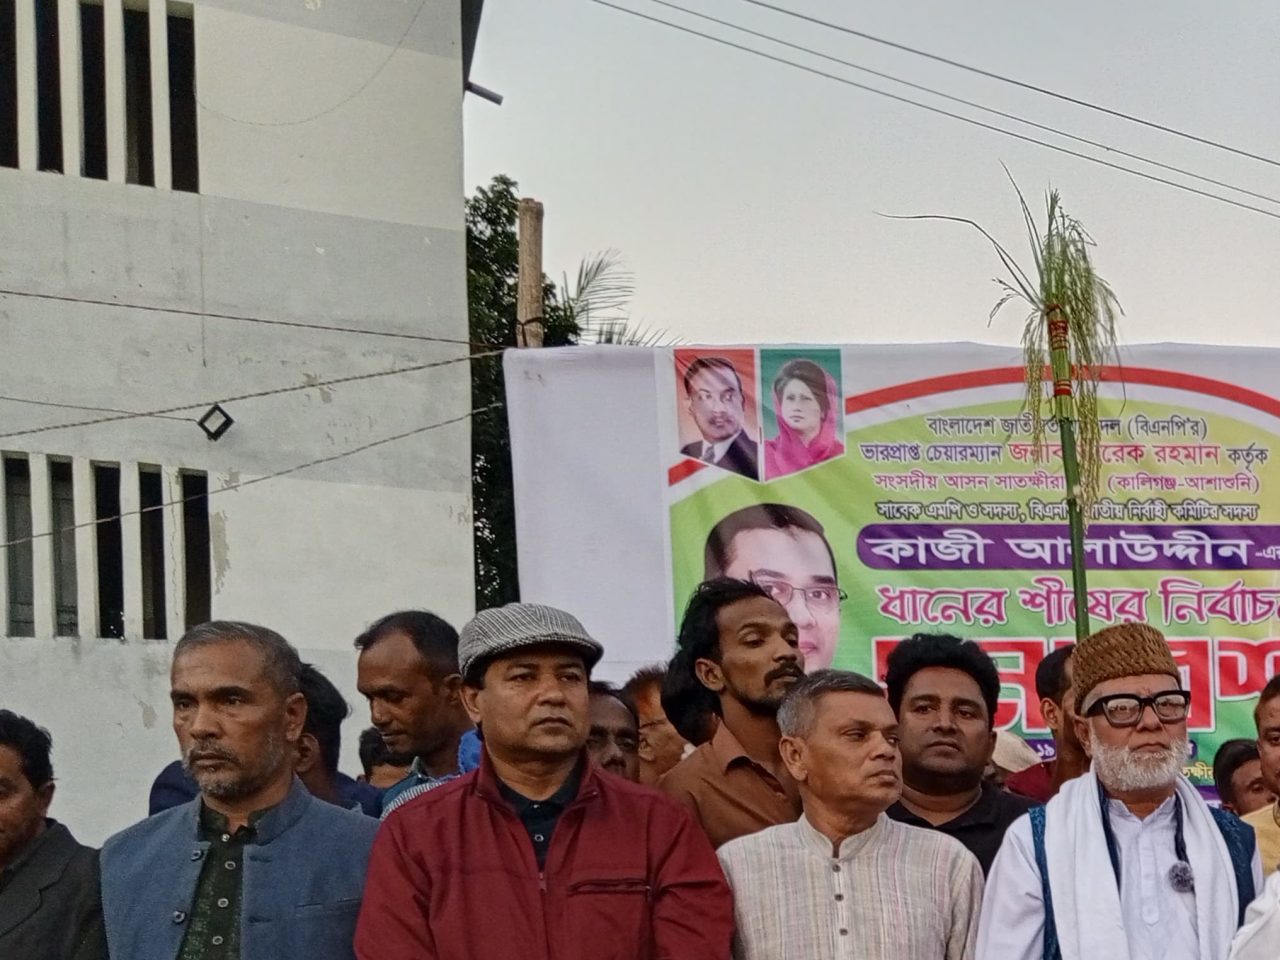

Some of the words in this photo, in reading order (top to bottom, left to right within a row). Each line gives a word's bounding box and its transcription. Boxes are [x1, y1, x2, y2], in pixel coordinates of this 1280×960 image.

[927, 417, 995, 435] বাংলাদেশ
[861, 443, 921, 462] ভারপ্রাপ্ত
[927, 444, 1001, 463] চেয়ারম্যান
[1154, 444, 1220, 464] রহমান
[1226, 442, 1268, 472] কর্তৃক
[874, 470, 938, 489] সংসদীয়
[943, 475, 988, 490] আসন
[877, 502, 923, 519] সাবেক
[926, 500, 961, 519] এমপি
[965, 504, 979, 518] ও
[866, 531, 993, 565] কাজী
[877, 584, 1007, 624] ধানের
